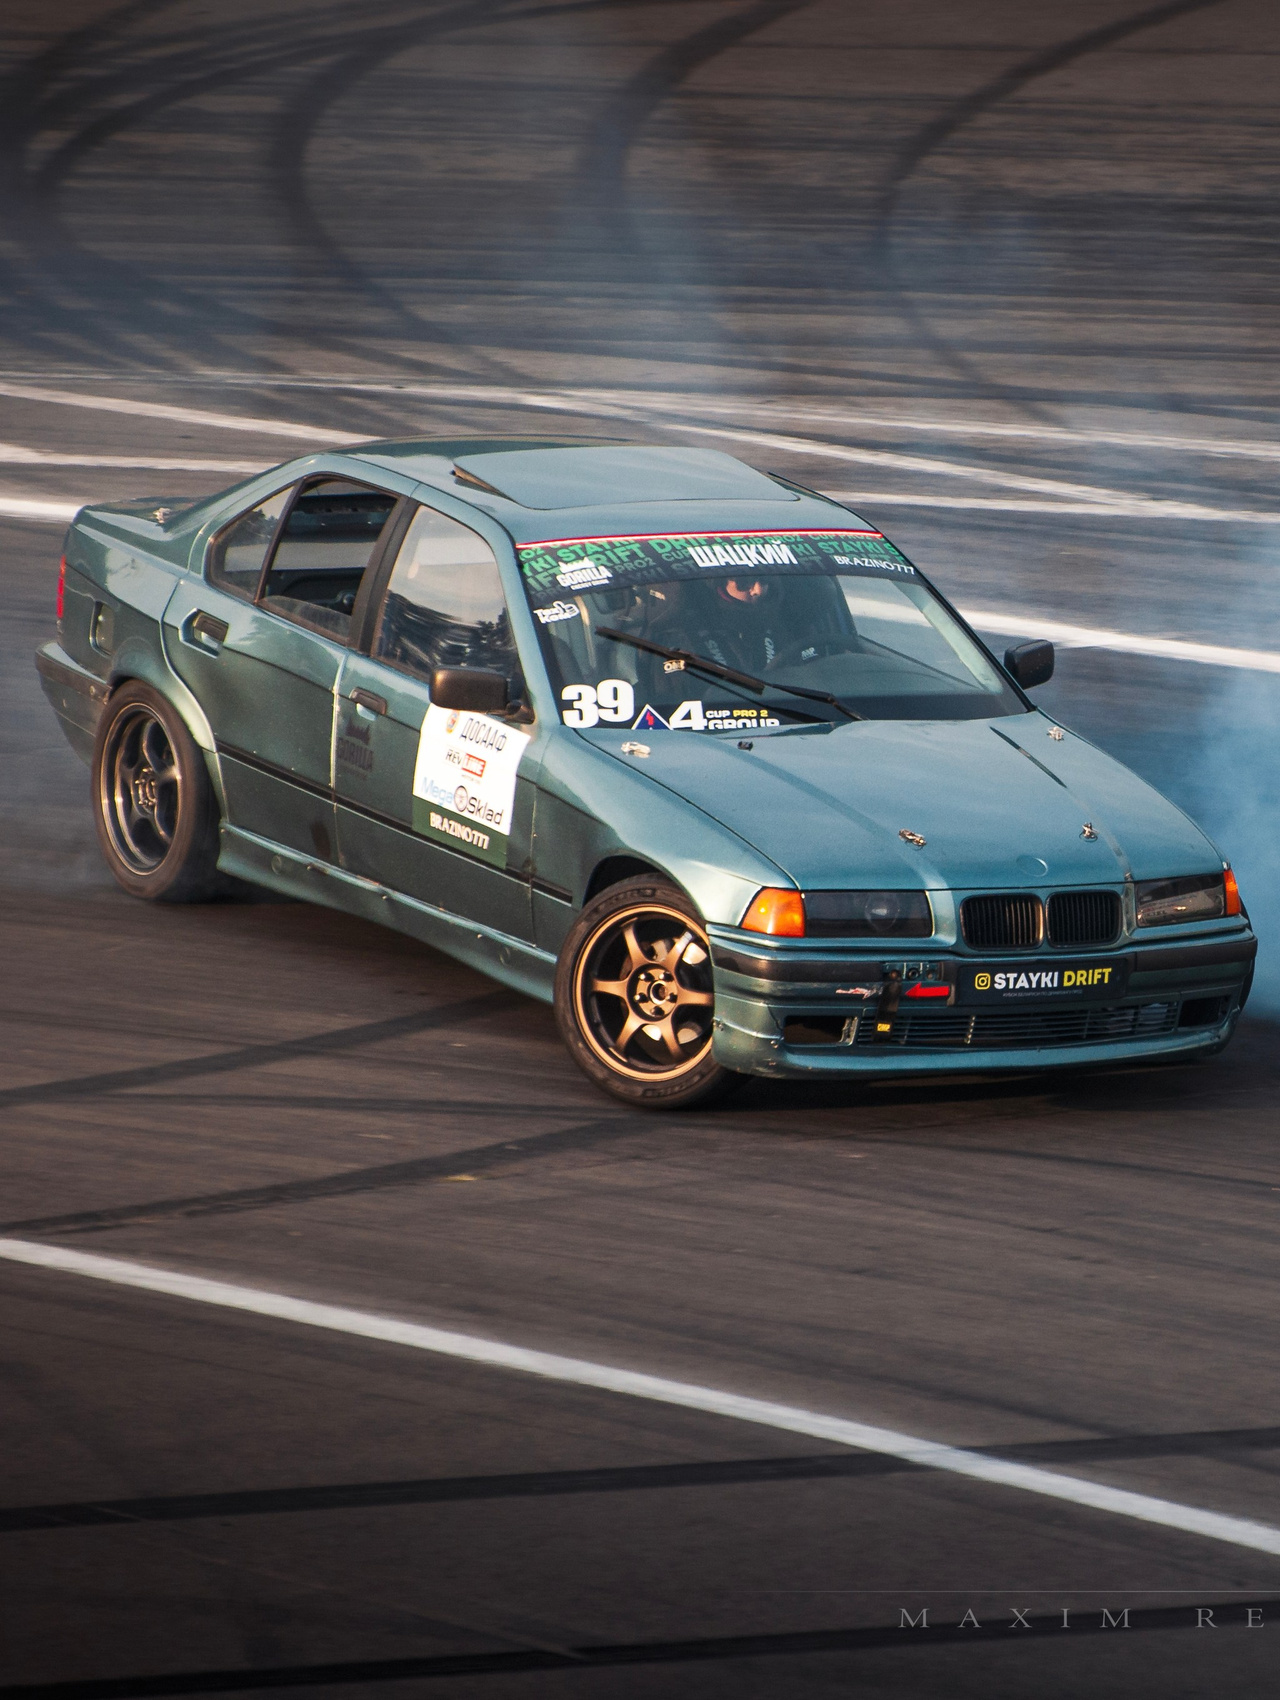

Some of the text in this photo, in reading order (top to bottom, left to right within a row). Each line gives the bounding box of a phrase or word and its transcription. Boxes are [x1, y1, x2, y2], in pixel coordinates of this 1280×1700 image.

[687, 539, 798, 568] ШАЦКИЙ
[833, 555, 915, 576] BRAZINO777
[556, 565, 613, 587] GORILLA
[561, 678, 634, 729] 39
[669, 700, 707, 730] 4
[705, 709, 769, 718] CUP PRO 2
[458, 716, 508, 753] ДОСААФ
[420, 776, 505, 826] Mega Sklad
[993, 967, 1112, 990] STAYKI DRIFT
